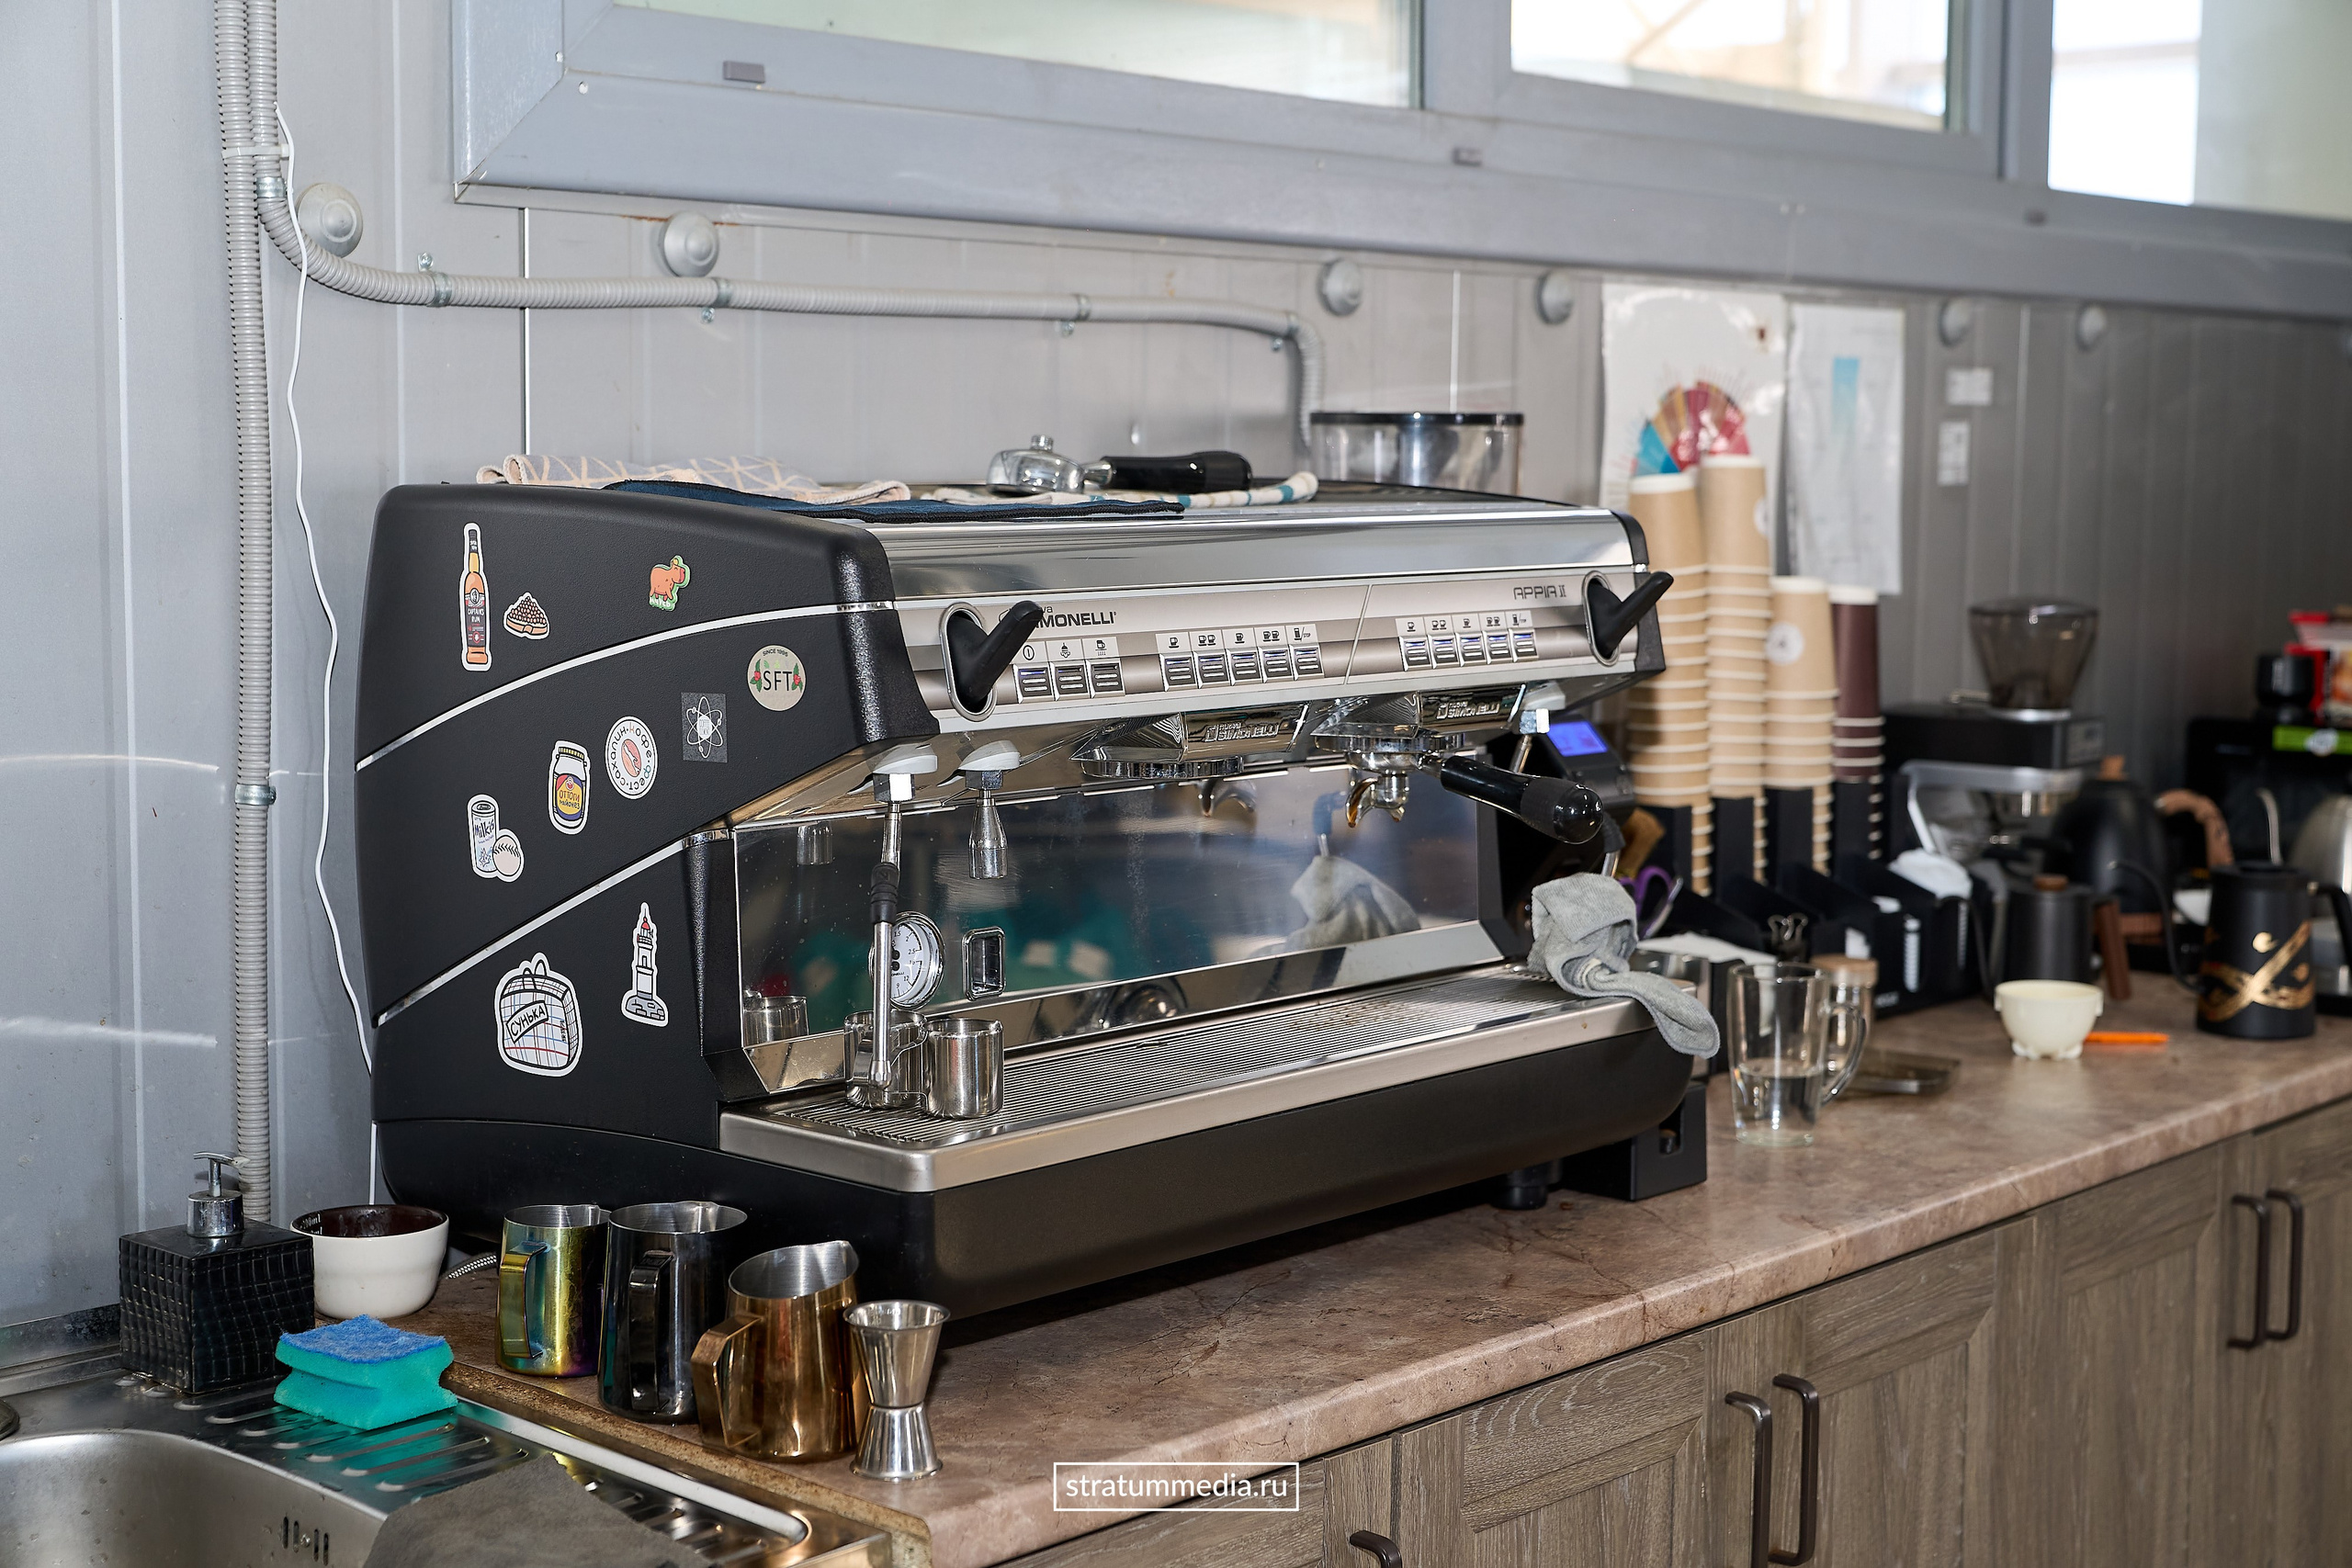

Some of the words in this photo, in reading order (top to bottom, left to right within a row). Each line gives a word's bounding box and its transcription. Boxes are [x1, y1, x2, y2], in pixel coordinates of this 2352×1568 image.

[1513, 585, 1557, 600] APPIA
[1035, 612, 1114, 628] MONELLI
[763, 671, 792, 691] SFT
[510, 1005, 546, 1037] СУНЬКА
